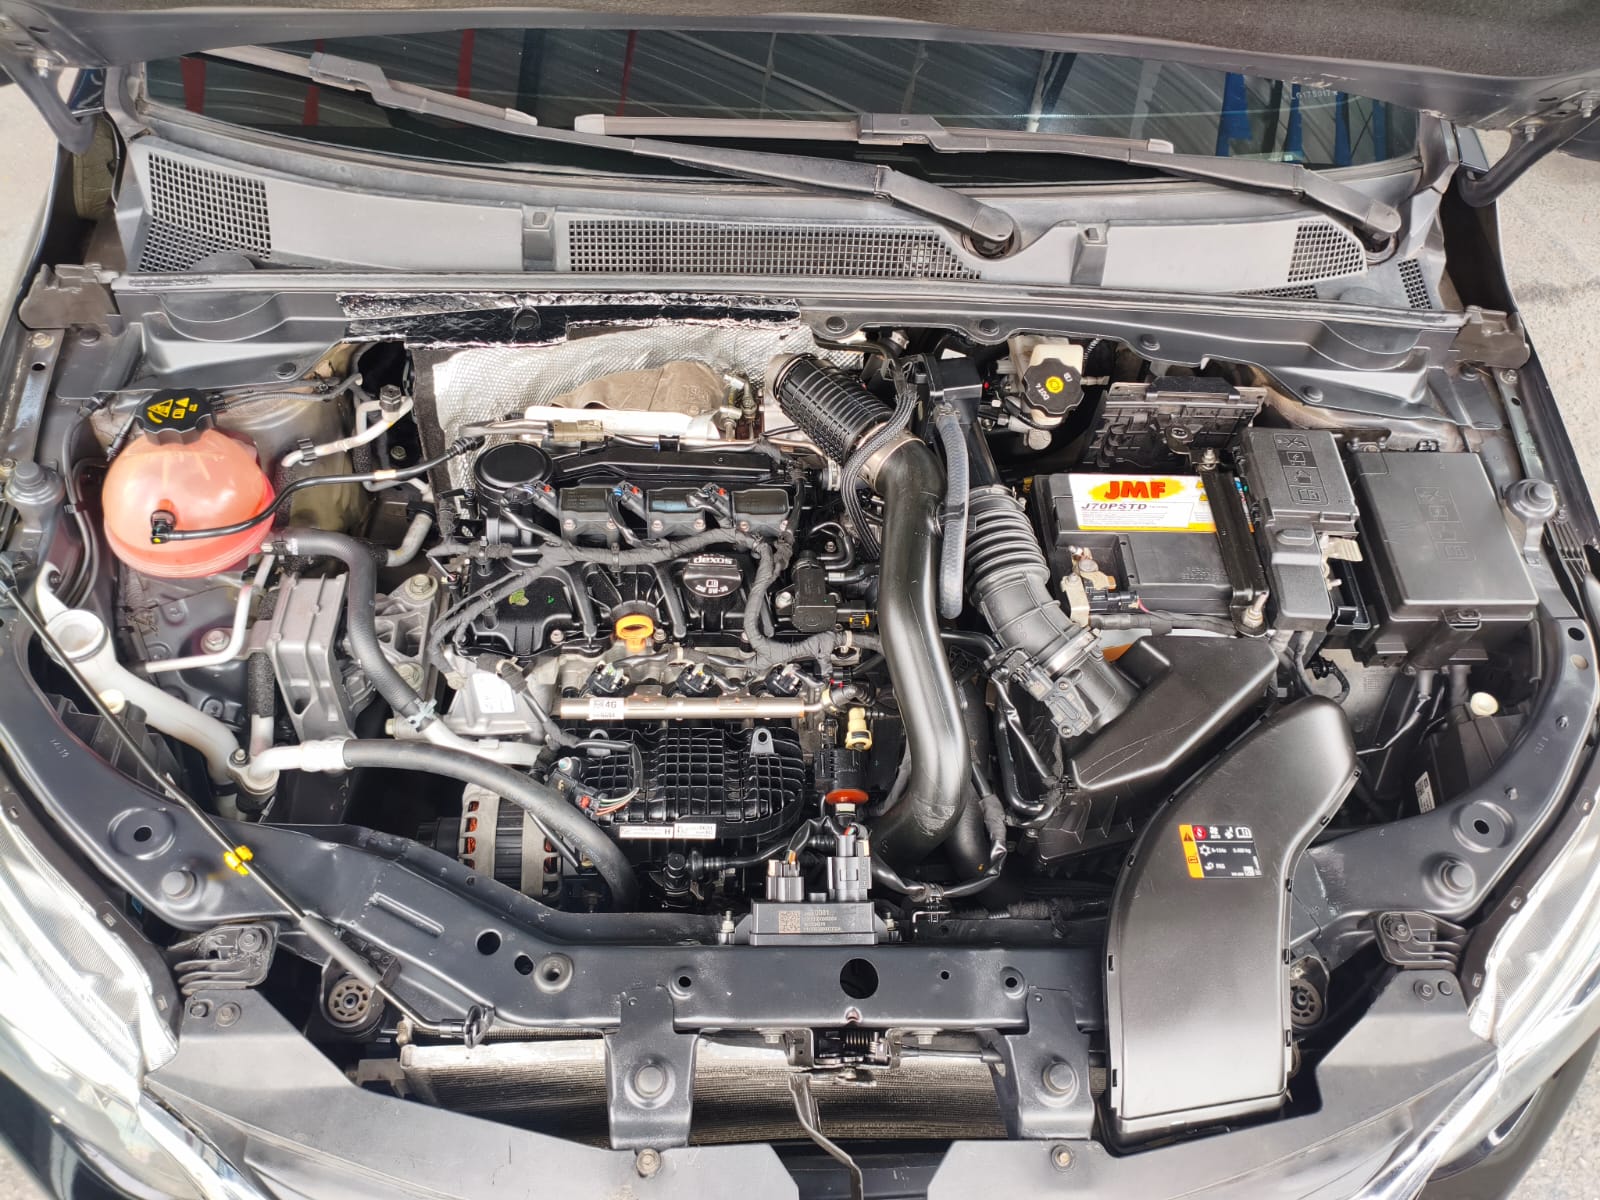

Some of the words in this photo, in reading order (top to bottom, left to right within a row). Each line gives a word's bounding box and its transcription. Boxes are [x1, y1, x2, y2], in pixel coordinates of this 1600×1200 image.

[1104, 480, 1166, 500] JMF
[1080, 502, 1148, 511] J70PSTD
[693, 555, 733, 565] dexos
